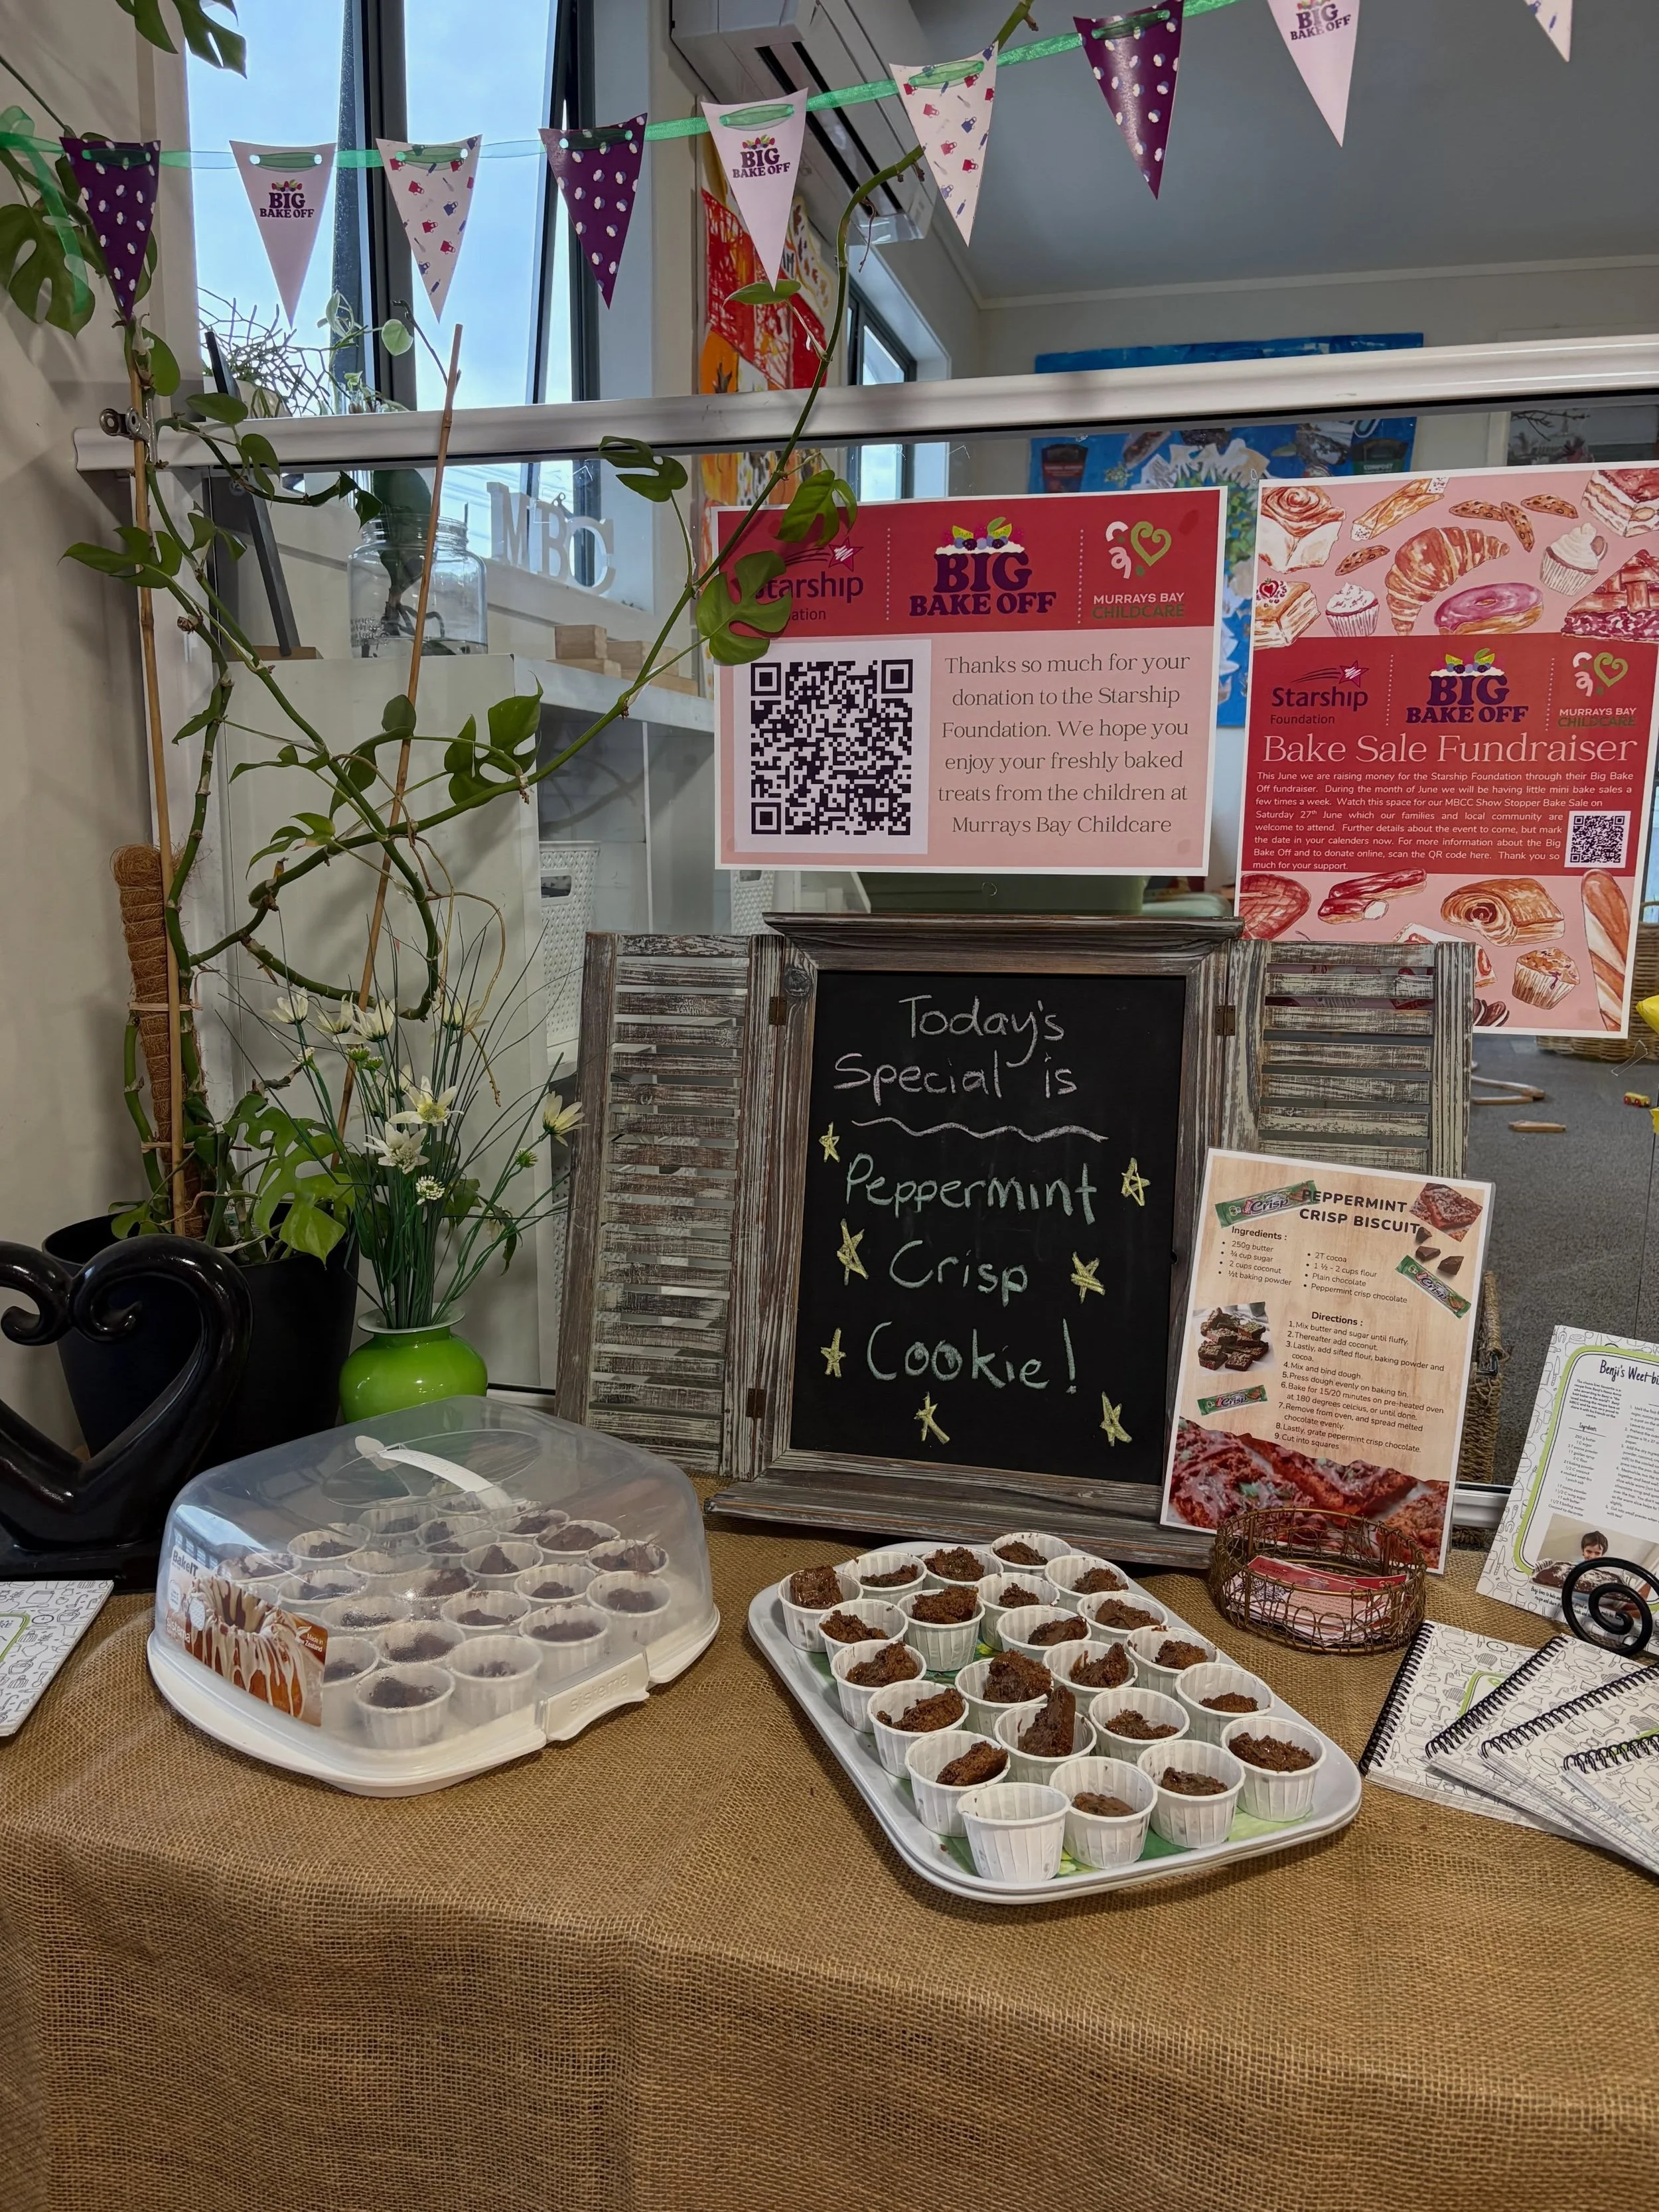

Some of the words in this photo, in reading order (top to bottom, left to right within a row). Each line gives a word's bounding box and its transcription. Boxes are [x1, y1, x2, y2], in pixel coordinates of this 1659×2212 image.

[1295, 4, 1338, 29] BIG
[1290, 27, 1325, 40] BAKE
[1325, 15, 1352, 32] OFF
[741, 147, 780, 168] BIG
[732, 167, 766, 179] BAKE
[767, 162, 790, 175] OFF
[269, 192, 306, 210] BIG
[259, 208, 291, 218] BAKE
[293, 208, 315, 218] OFF
[932, 551, 1033, 593] BIG
[755, 571, 864, 604] tarship
[909, 593, 991, 617] BAKE
[996, 591, 1057, 615] OFF
[1093, 593, 1157, 605] MURRAYS
[1160, 592, 1185, 603] BAY
[1092, 603, 1185, 620] CHILDCARE
[944, 655, 1017, 674] Thanks
[1021, 660, 1042, 673] so
[1047, 653, 1102, 672] much
[1109, 653, 1138, 671] for
[1141, 656, 1190, 674] your
[952, 688, 1035, 706] donation
[1039, 690, 1058, 705] to
[1062, 686, 1093, 705] the
[1098, 684, 1180, 709] Starship
[1271, 686, 1368, 712] Starship
[1426, 674, 1510, 707] BIG
[1270, 713, 1335, 725] Foundation
[1405, 706, 1475, 724] BAKE
[1478, 705, 1529, 723] OFF
[1557, 714, 1636, 727] CHILDCARE
[1559, 707, 1613, 716] MURRAYS
[942, 720, 1051, 739] Foundation.
[1056, 720, 1094, 737] We
[1099, 719, 1147, 742] hope
[1150, 723, 1188, 740] you
[1262, 733, 1346, 762] Bake
[1355, 732, 1427, 763] Sale
[1437, 732, 1638, 762] Fundraiser
[945, 753, 996, 774] enjoy
[999, 757, 1046, 774] your
[1050, 751, 1119, 773] freshly
[1123, 749, 1183, 769] baked
[1333, 772, 1362, 781] raising
[1431, 772, 1467, 781] Starship
[1525, 772, 1561, 781] through
[1590, 771, 1606, 781] Big
[938, 786, 991, 802] treats
[995, 784, 1043, 801] from
[1047, 783, 1078, 801] the
[1083, 782, 1165, 801] children
[1171, 785, 1188, 800] at
[952, 816, 1031, 837] Murrays
[1036, 816, 1072, 837] Bay
[1077, 815, 1171, 833] Childcare
[1256, 810, 1294, 820] Saturday
[1491, 812, 1542, 822] community
[899, 995, 1064, 1067] Today's
[833, 1050, 1002, 1106] Special
[1045, 1052, 1078, 1099] is
[846, 1153, 1098, 1225] Peppermint
[1250, 1199, 1289, 1213] Crisp
[1302, 1189, 1407, 1213] PEPPERMINT
[1299, 1208, 1348, 1224] CRISP
[1354, 1215, 1420, 1235] BISCUIT
[1232, 1225, 1281, 1240] Ingredients
[1231, 1240, 1250, 1250] 250g
[1252, 1243, 1273, 1252] butter
[889, 1240, 1028, 1307] Crisp
[1239, 1271, 1262, 1282] baking
[1253, 1265, 1281, 1274] coconut
[1312, 1272, 1330, 1281] Plain
[1331, 1276, 1366, 1286] chocolate
[1311, 1283, 1352, 1295] Peppermint
[1353, 1290, 1371, 1299] crisp
[1372, 1292, 1407, 1303] chocolate
[1421, 1278, 1447, 1299] Crisp
[1311, 1311, 1357, 1325] Directions
[867, 1318, 1078, 1394] Cookie!
[1599, 1359, 1625, 1382] Benji's
[1310, 1376, 1333, 1386] dough
[1334, 1381, 1358, 1390] evenly
[1371, 1385, 1396, 1396] baking
[1222, 1396, 1247, 1406] Crisp
[1295, 1394, 1310, 1402] 180
[1311, 1397, 1340, 1408] degrees
[1342, 1403, 1368, 1412] celcius,
[1397, 1411, 1417, 1420] done.
[1283, 1414, 1319, 1425] chocolate
[1319, 1420, 1344, 1430] evenly.
[173, 1550, 198, 1577] BakeIT
[305, 1640, 323, 1653] Zealand
[307, 1633, 319, 1644] Made
